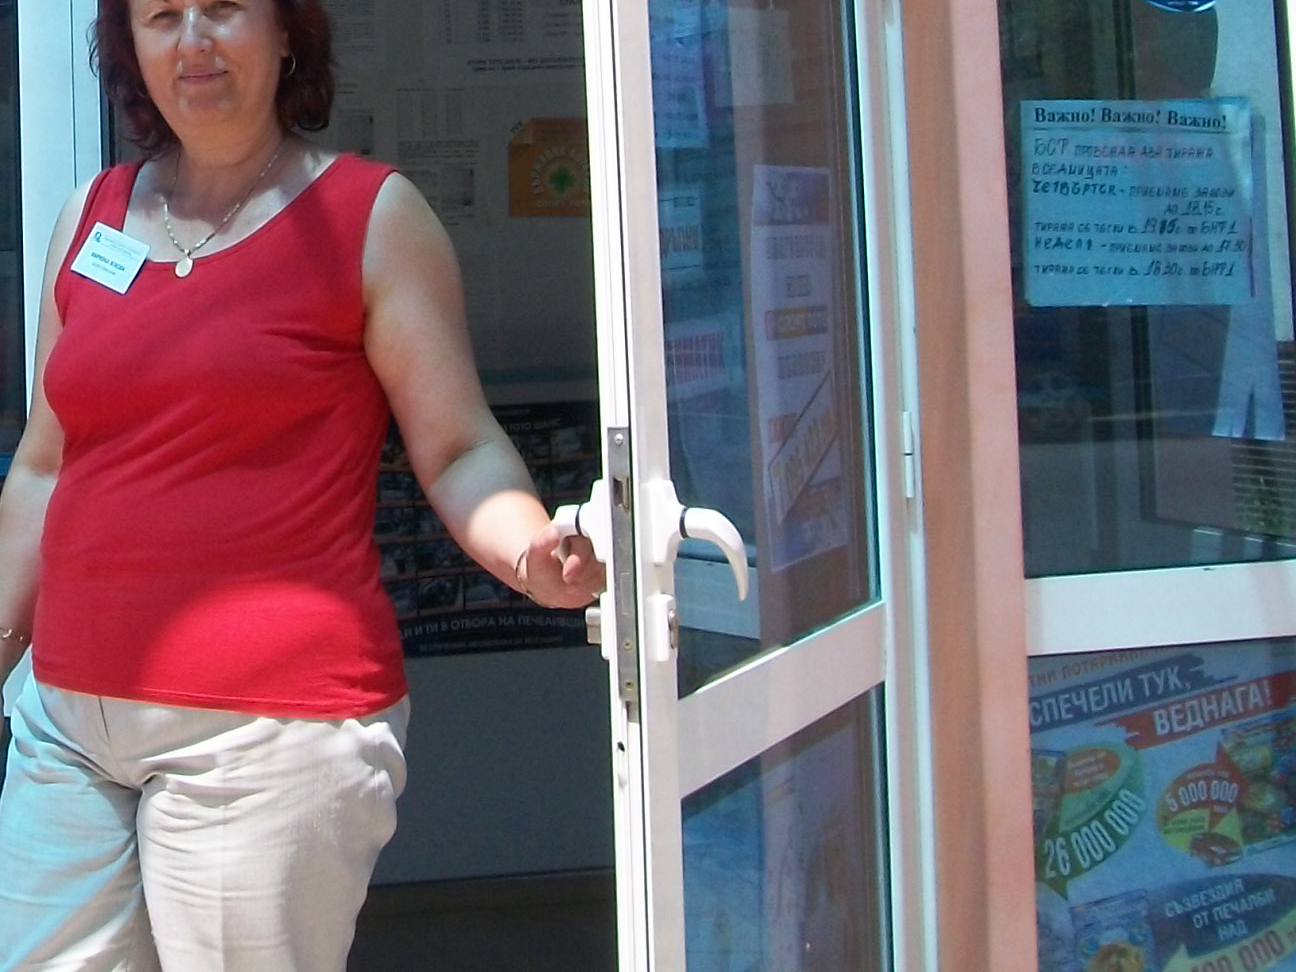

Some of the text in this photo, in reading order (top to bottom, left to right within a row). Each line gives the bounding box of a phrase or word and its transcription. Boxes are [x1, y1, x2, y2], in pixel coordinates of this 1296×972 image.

[1034, 107, 1228, 129] Важно! Важно! Важно!
[1031, 679, 1135, 727] СПЕЧЕЛИ
[1154, 679, 1273, 736] ВЕДНАГА!
[1044, 787, 1147, 879] 26 000 000
